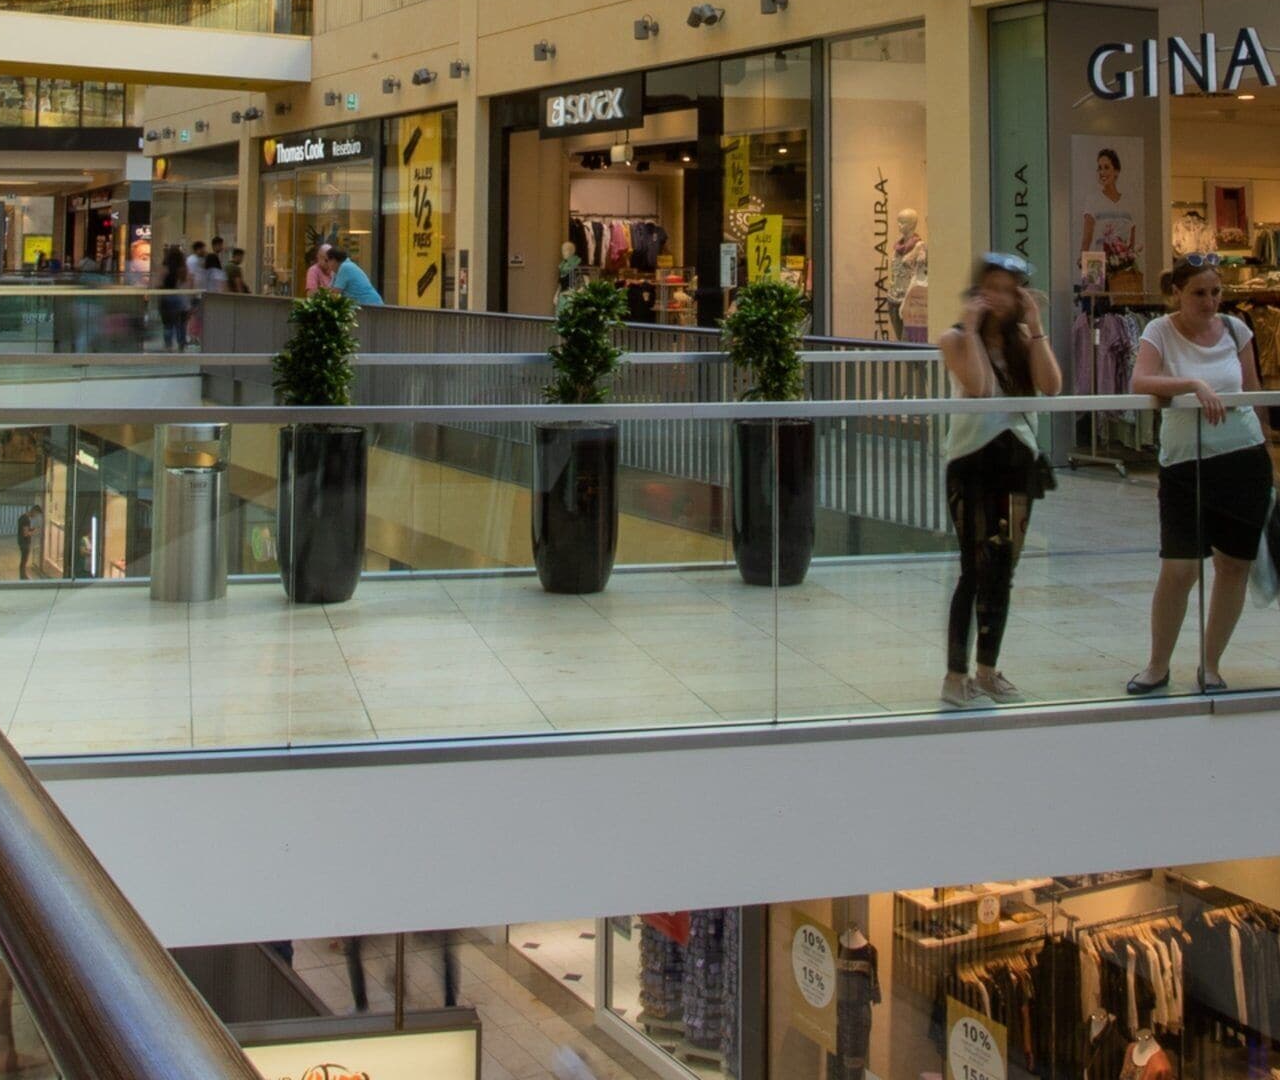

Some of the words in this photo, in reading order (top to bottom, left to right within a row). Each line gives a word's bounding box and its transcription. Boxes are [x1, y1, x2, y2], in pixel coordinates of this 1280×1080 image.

[276, 143, 305, 164] Thomas
[305, 137, 325, 160] Cook
[802, 929, 826, 954] 10%
[802, 966, 825, 991] 15%
[962, 1022, 992, 1051] 10%
